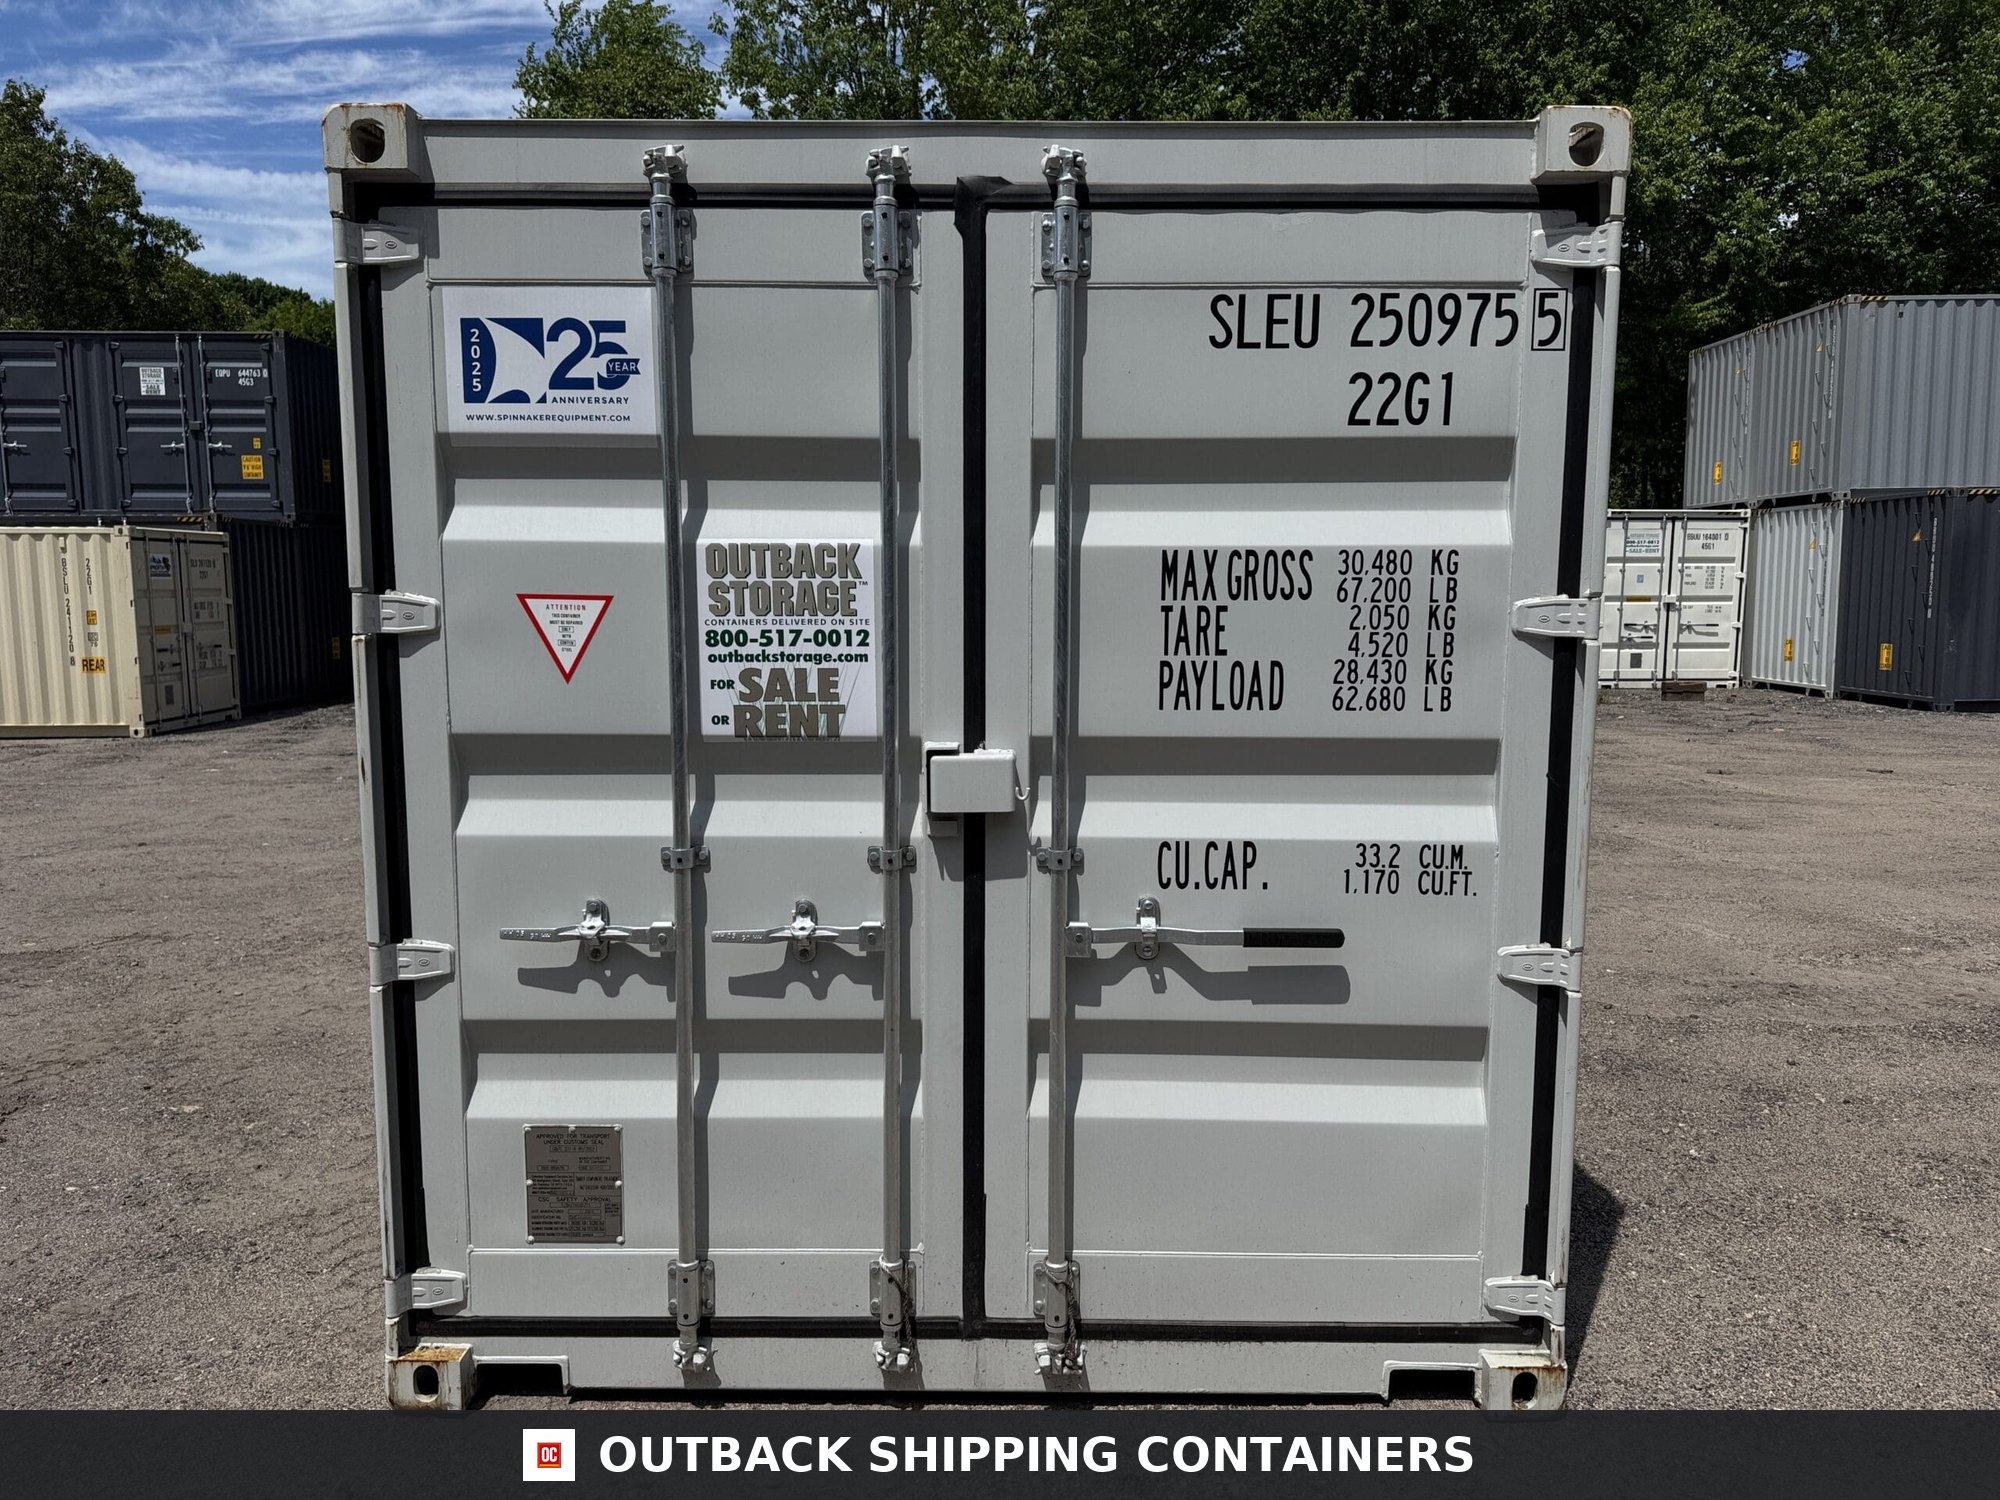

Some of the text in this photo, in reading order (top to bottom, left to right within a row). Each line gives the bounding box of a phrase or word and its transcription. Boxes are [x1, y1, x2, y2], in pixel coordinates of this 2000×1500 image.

[1209, 291, 1564, 349] SLEU 250975 5
[215, 369, 231, 377] EQPU
[238, 369, 261, 377] 644763
[470, 328, 482, 392] 2025
[608, 361, 637, 372] YEAR
[551, 396, 630, 405] ANNIVERSARY
[1347, 371, 1454, 426] 22G1
[466, 413, 631, 422] WWW.SPINNAKEREQUIPMENT.COM
[61, 558, 69, 594] BSLU
[705, 543, 862, 579] OUTBACK
[1160, 548, 1459, 601] MAX GROSS 30,480 KG
[708, 580, 858, 617] STORAGE
[1336, 577, 1458, 603] 67,200 LB
[65, 598, 75, 653] 241120
[704, 618, 871, 626] CONTAINERS DELIVERED ON SITE
[705, 629, 870, 647] 800-517-0012
[1160, 605, 1456, 656] TARE 2,050 KG
[707, 649, 869, 665] outbackstorage.com
[1347, 632, 1455, 658] 4,520 LB
[82, 658, 105, 672] REAR
[710, 667, 840, 702] FOR SALE
[1158, 659, 1453, 711] PAYLOAD 28,430 KG
[1331, 686, 1452, 712] 62,680 LB
[711, 705, 846, 738] OR RENT
[1157, 840, 1468, 890] CU.CAP. 33.2 CU.M.
[1343, 869, 1477, 896] 1,170 CU.FT.
